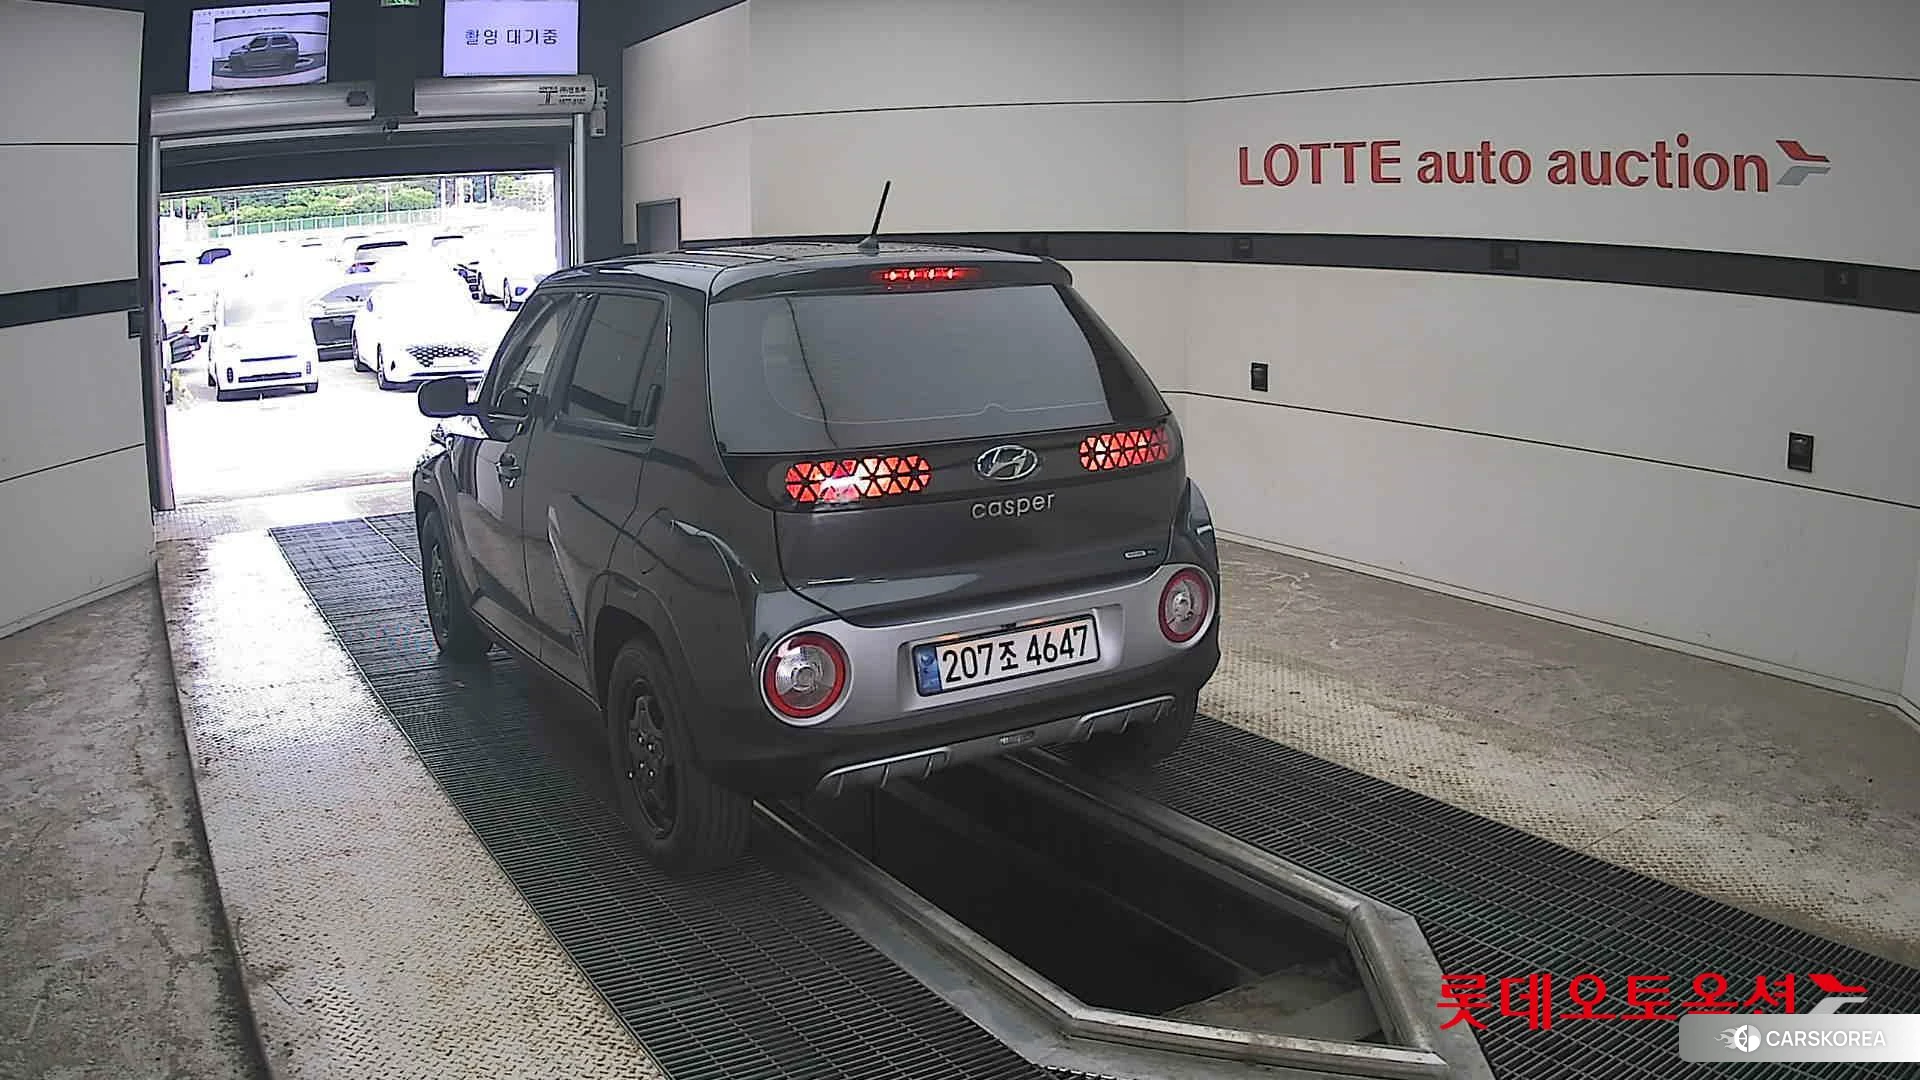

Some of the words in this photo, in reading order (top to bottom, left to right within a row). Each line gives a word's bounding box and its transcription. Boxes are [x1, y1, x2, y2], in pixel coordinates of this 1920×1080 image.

[506, 29, 558, 45] 대기중
[1239, 140, 1401, 186] LOTTE
[1416, 140, 1532, 185] auto
[1547, 133, 1769, 192] auction
[972, 494, 1054, 518] casper
[942, 640, 1019, 683] 207조
[1026, 625, 1088, 665] 4647
